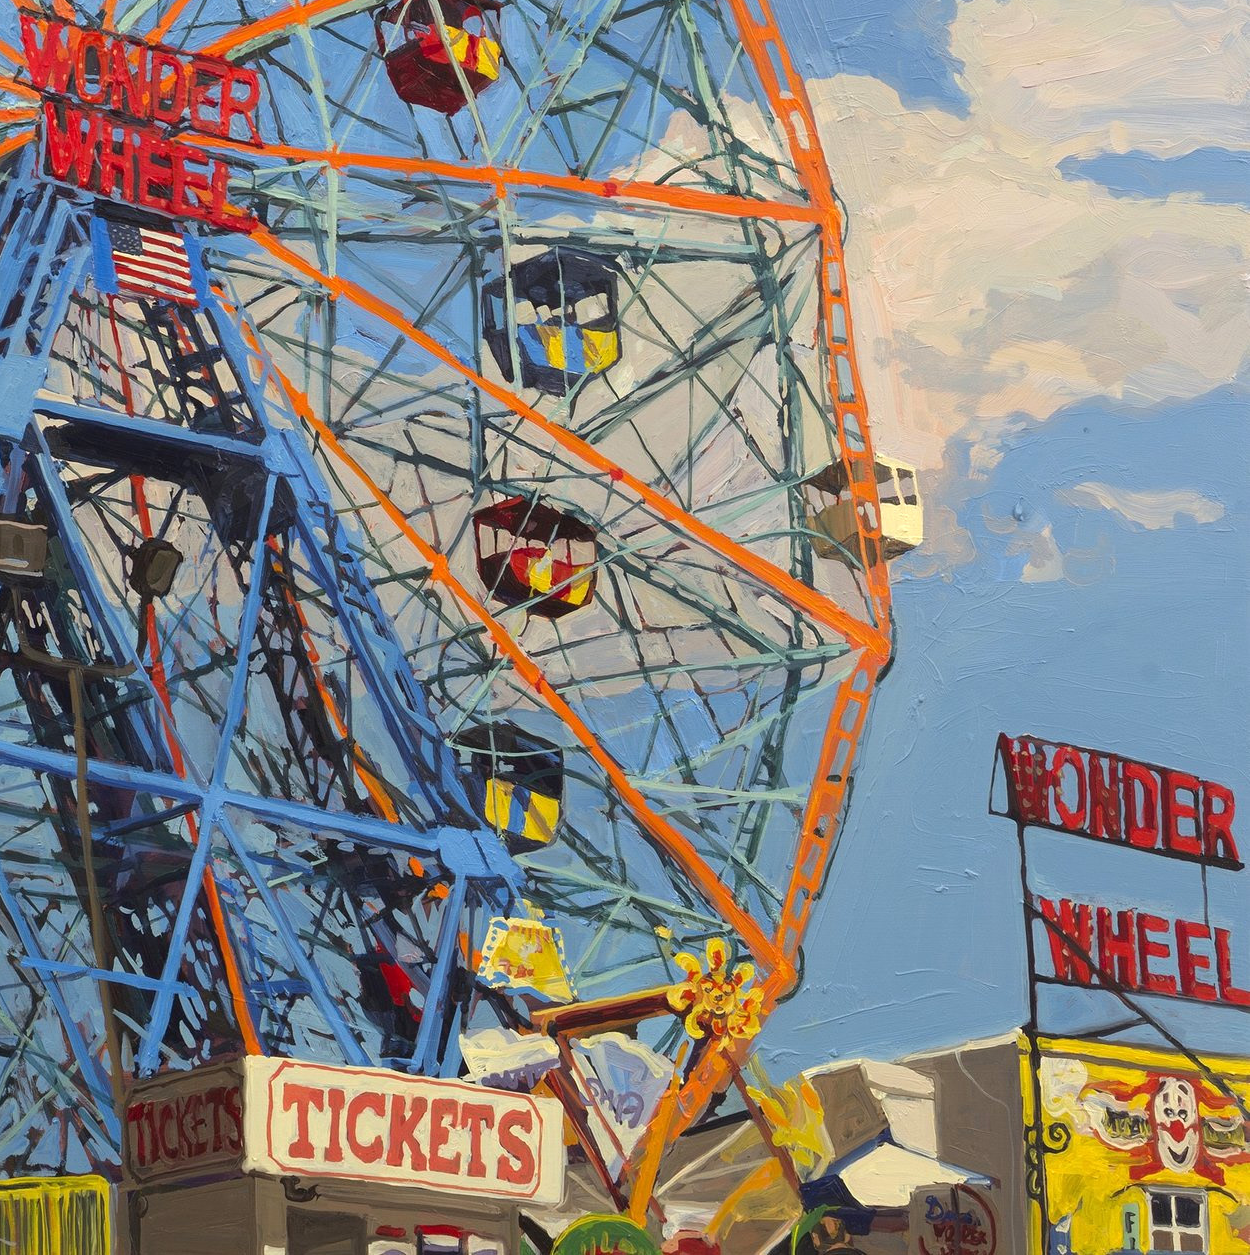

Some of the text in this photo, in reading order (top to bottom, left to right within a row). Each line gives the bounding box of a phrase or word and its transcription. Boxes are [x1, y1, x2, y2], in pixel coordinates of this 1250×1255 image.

[20, 14, 263, 149] WONDER
[45, 101, 258, 233] WHEEL
[999, 733, 1240, 861] WONDER
[1039, 897, 1250, 1006] WHEEL
[127, 1087, 242, 1166] TICKETS
[283, 1082, 535, 1185] TICKETS
